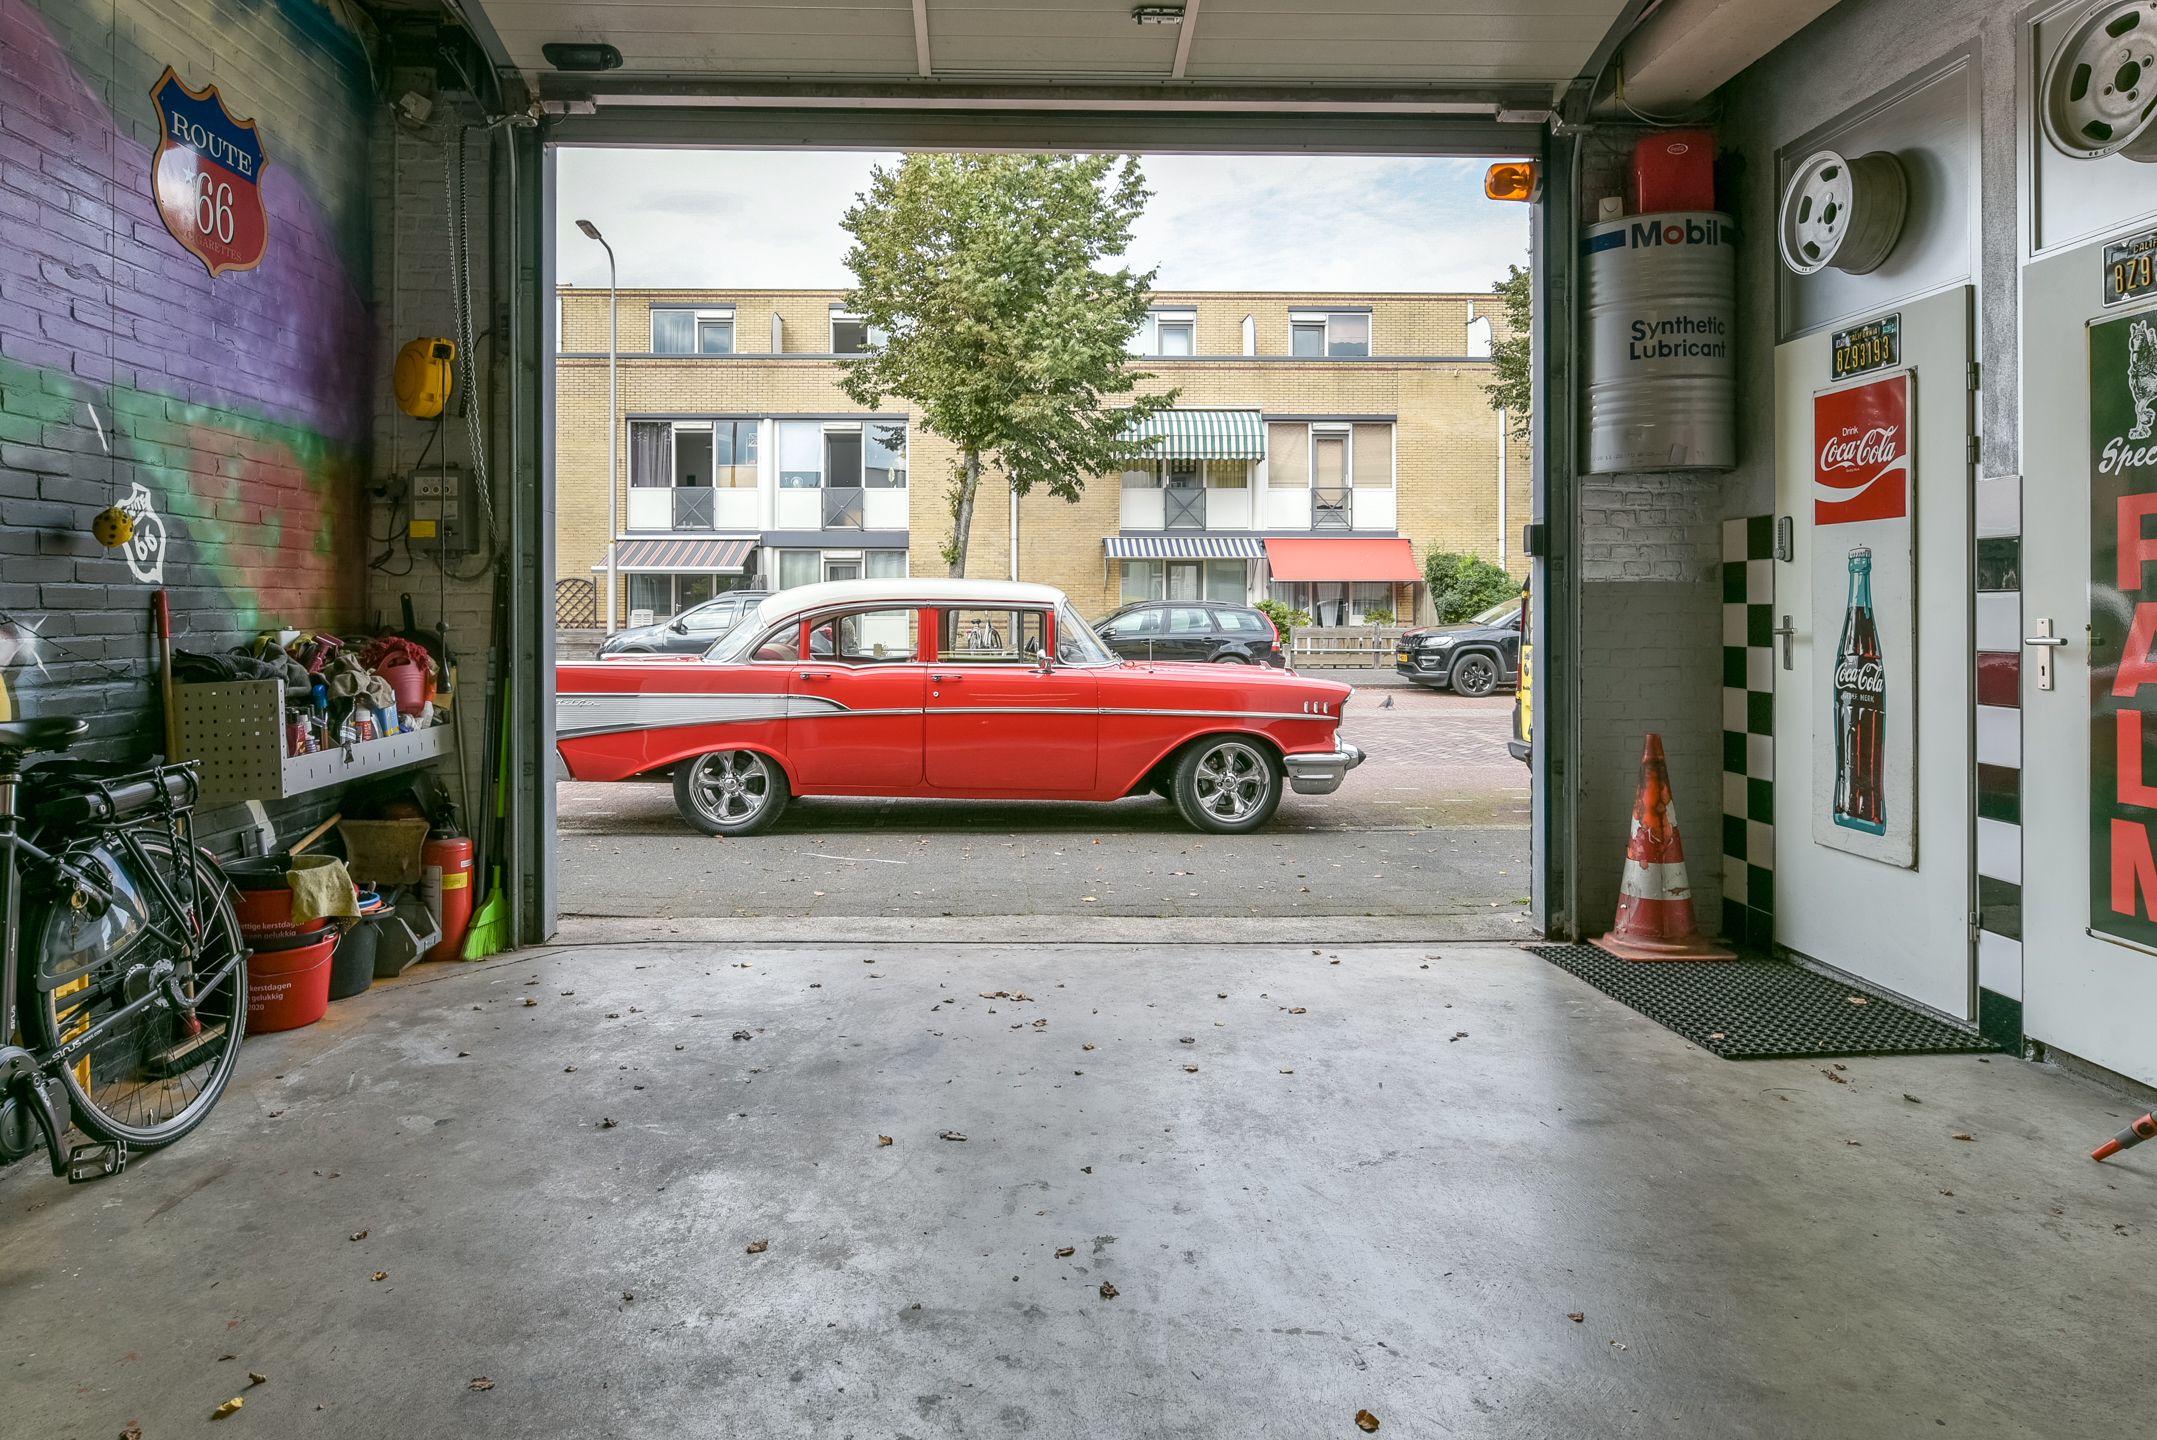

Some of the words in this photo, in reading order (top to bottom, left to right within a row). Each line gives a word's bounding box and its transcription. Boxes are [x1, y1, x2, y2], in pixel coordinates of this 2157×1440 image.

[171, 110, 252, 176] ROUTE
[195, 171, 235, 245] 66
[184, 230, 242, 262] CIGARETTES
[1631, 218, 1718, 249] Mobil
[2114, 255, 2157, 294] 8Z9
[1631, 315, 1726, 341] Synthetic
[1629, 339, 1726, 360] Lubricant
[1836, 335, 1889, 372] 8Z93193
[1842, 426, 1859, 437] Drink
[1820, 425, 1899, 472] Coca-Cola
[134, 524, 158, 561] 66
[1834, 662, 1884, 693] Coca-Cola
[249, 982, 292, 993] kerstdagen
[251, 992, 284, 1002] gelukkig
